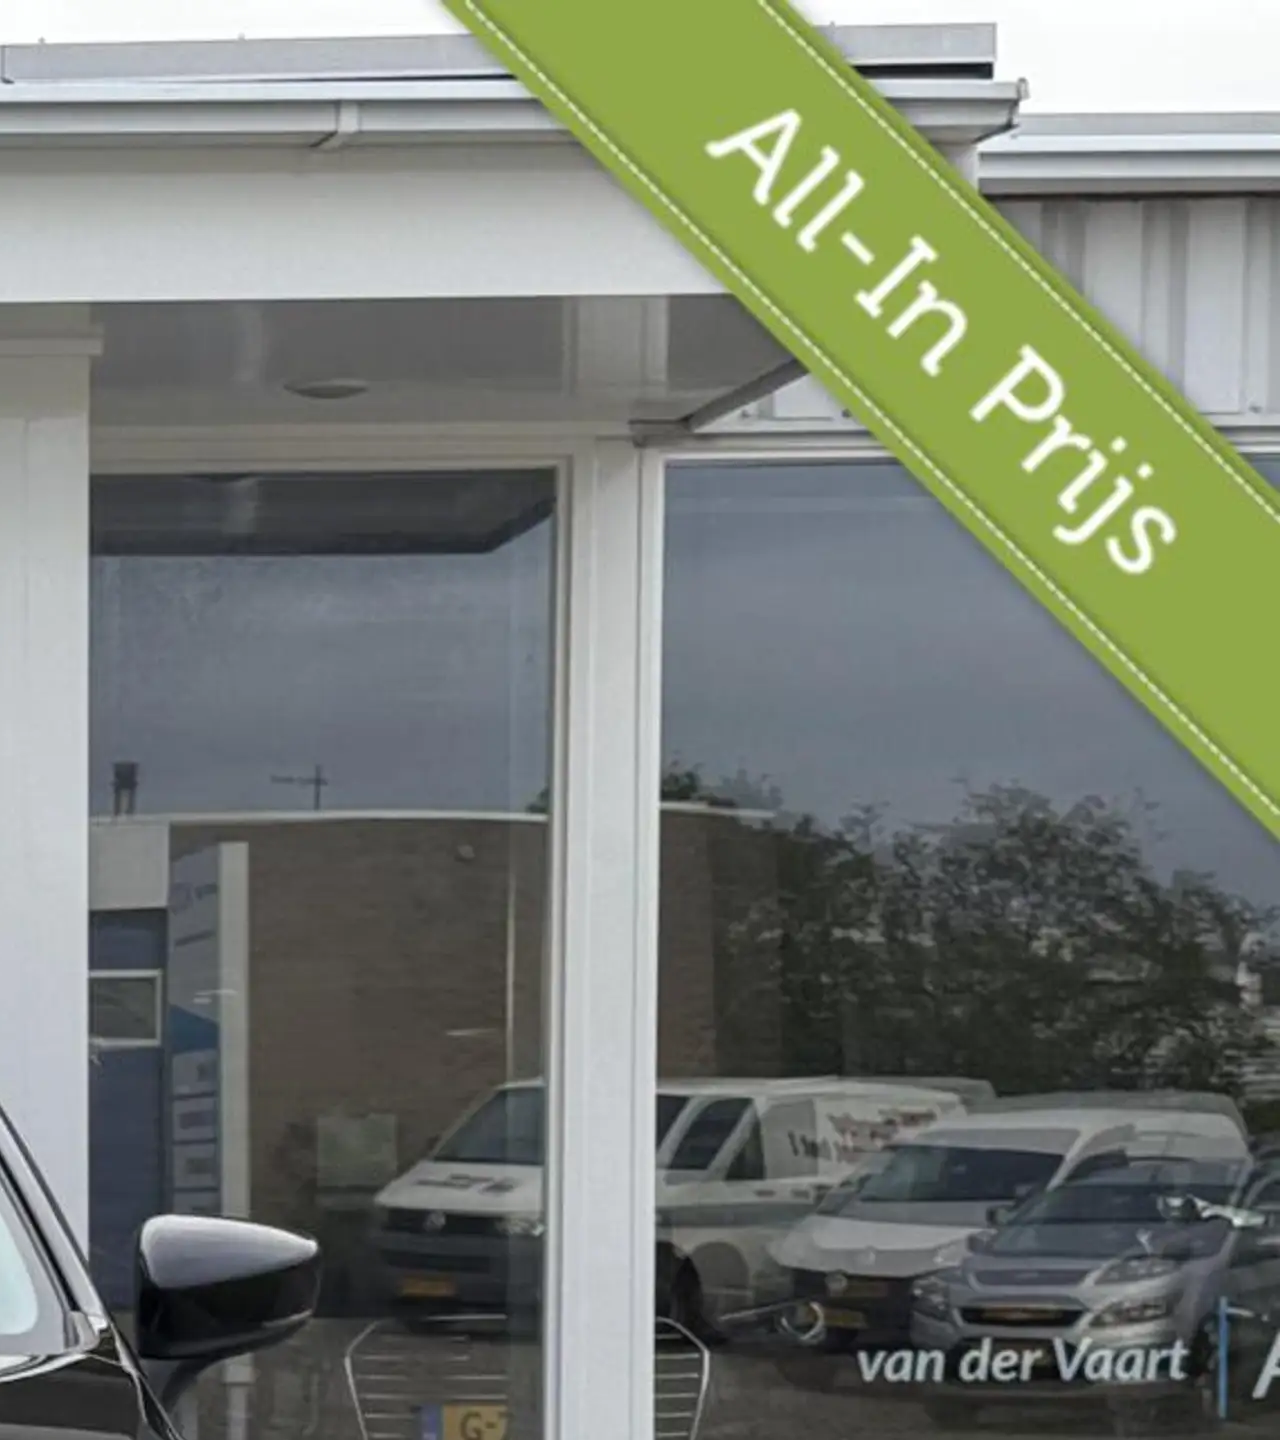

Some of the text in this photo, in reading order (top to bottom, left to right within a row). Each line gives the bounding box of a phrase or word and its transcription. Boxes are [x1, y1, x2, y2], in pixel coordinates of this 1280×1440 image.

[857, 1337, 1190, 1382] van der Vaart
